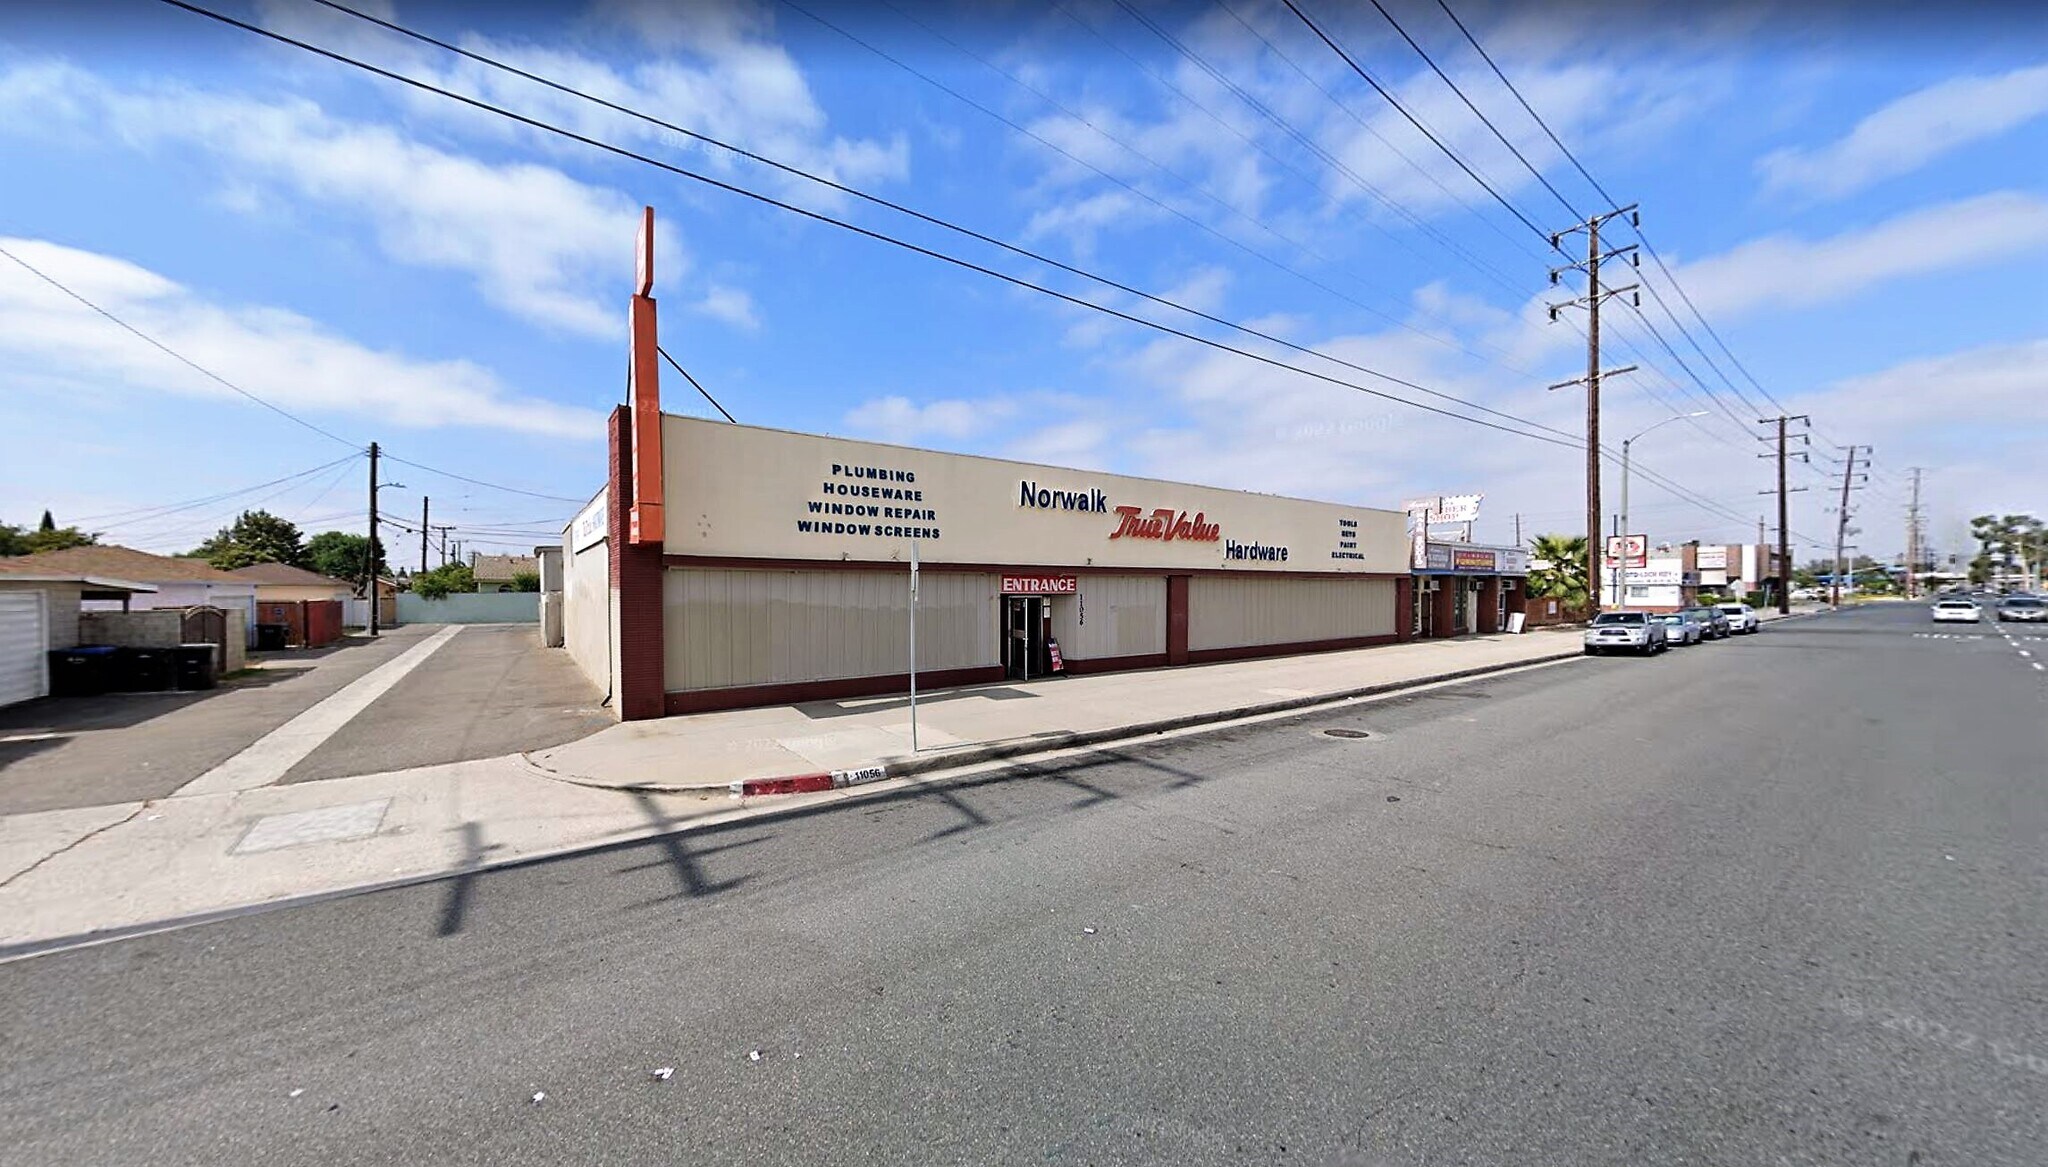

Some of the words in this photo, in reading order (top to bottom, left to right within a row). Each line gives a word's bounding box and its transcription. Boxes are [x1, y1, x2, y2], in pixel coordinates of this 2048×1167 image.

[832, 464, 915, 482] PLUMBING
[823, 482, 923, 501] HOUSEWARE
[1019, 480, 1108, 513] Norwalk
[808, 501, 879, 517] WINDOW
[884, 507, 936, 521] REPAIR
[797, 520, 871, 536] WINDOW
[875, 525, 940, 539] SCREENS
[1339, 519, 1358, 528] TOOLS
[1225, 539, 1288, 562] Hardware
[1340, 541, 1357, 549] PAINT
[1331, 551, 1365, 560] ELECTRICAL
[1003, 578, 1076, 591] ENTRANCE
[854, 768, 881, 781] 11056
